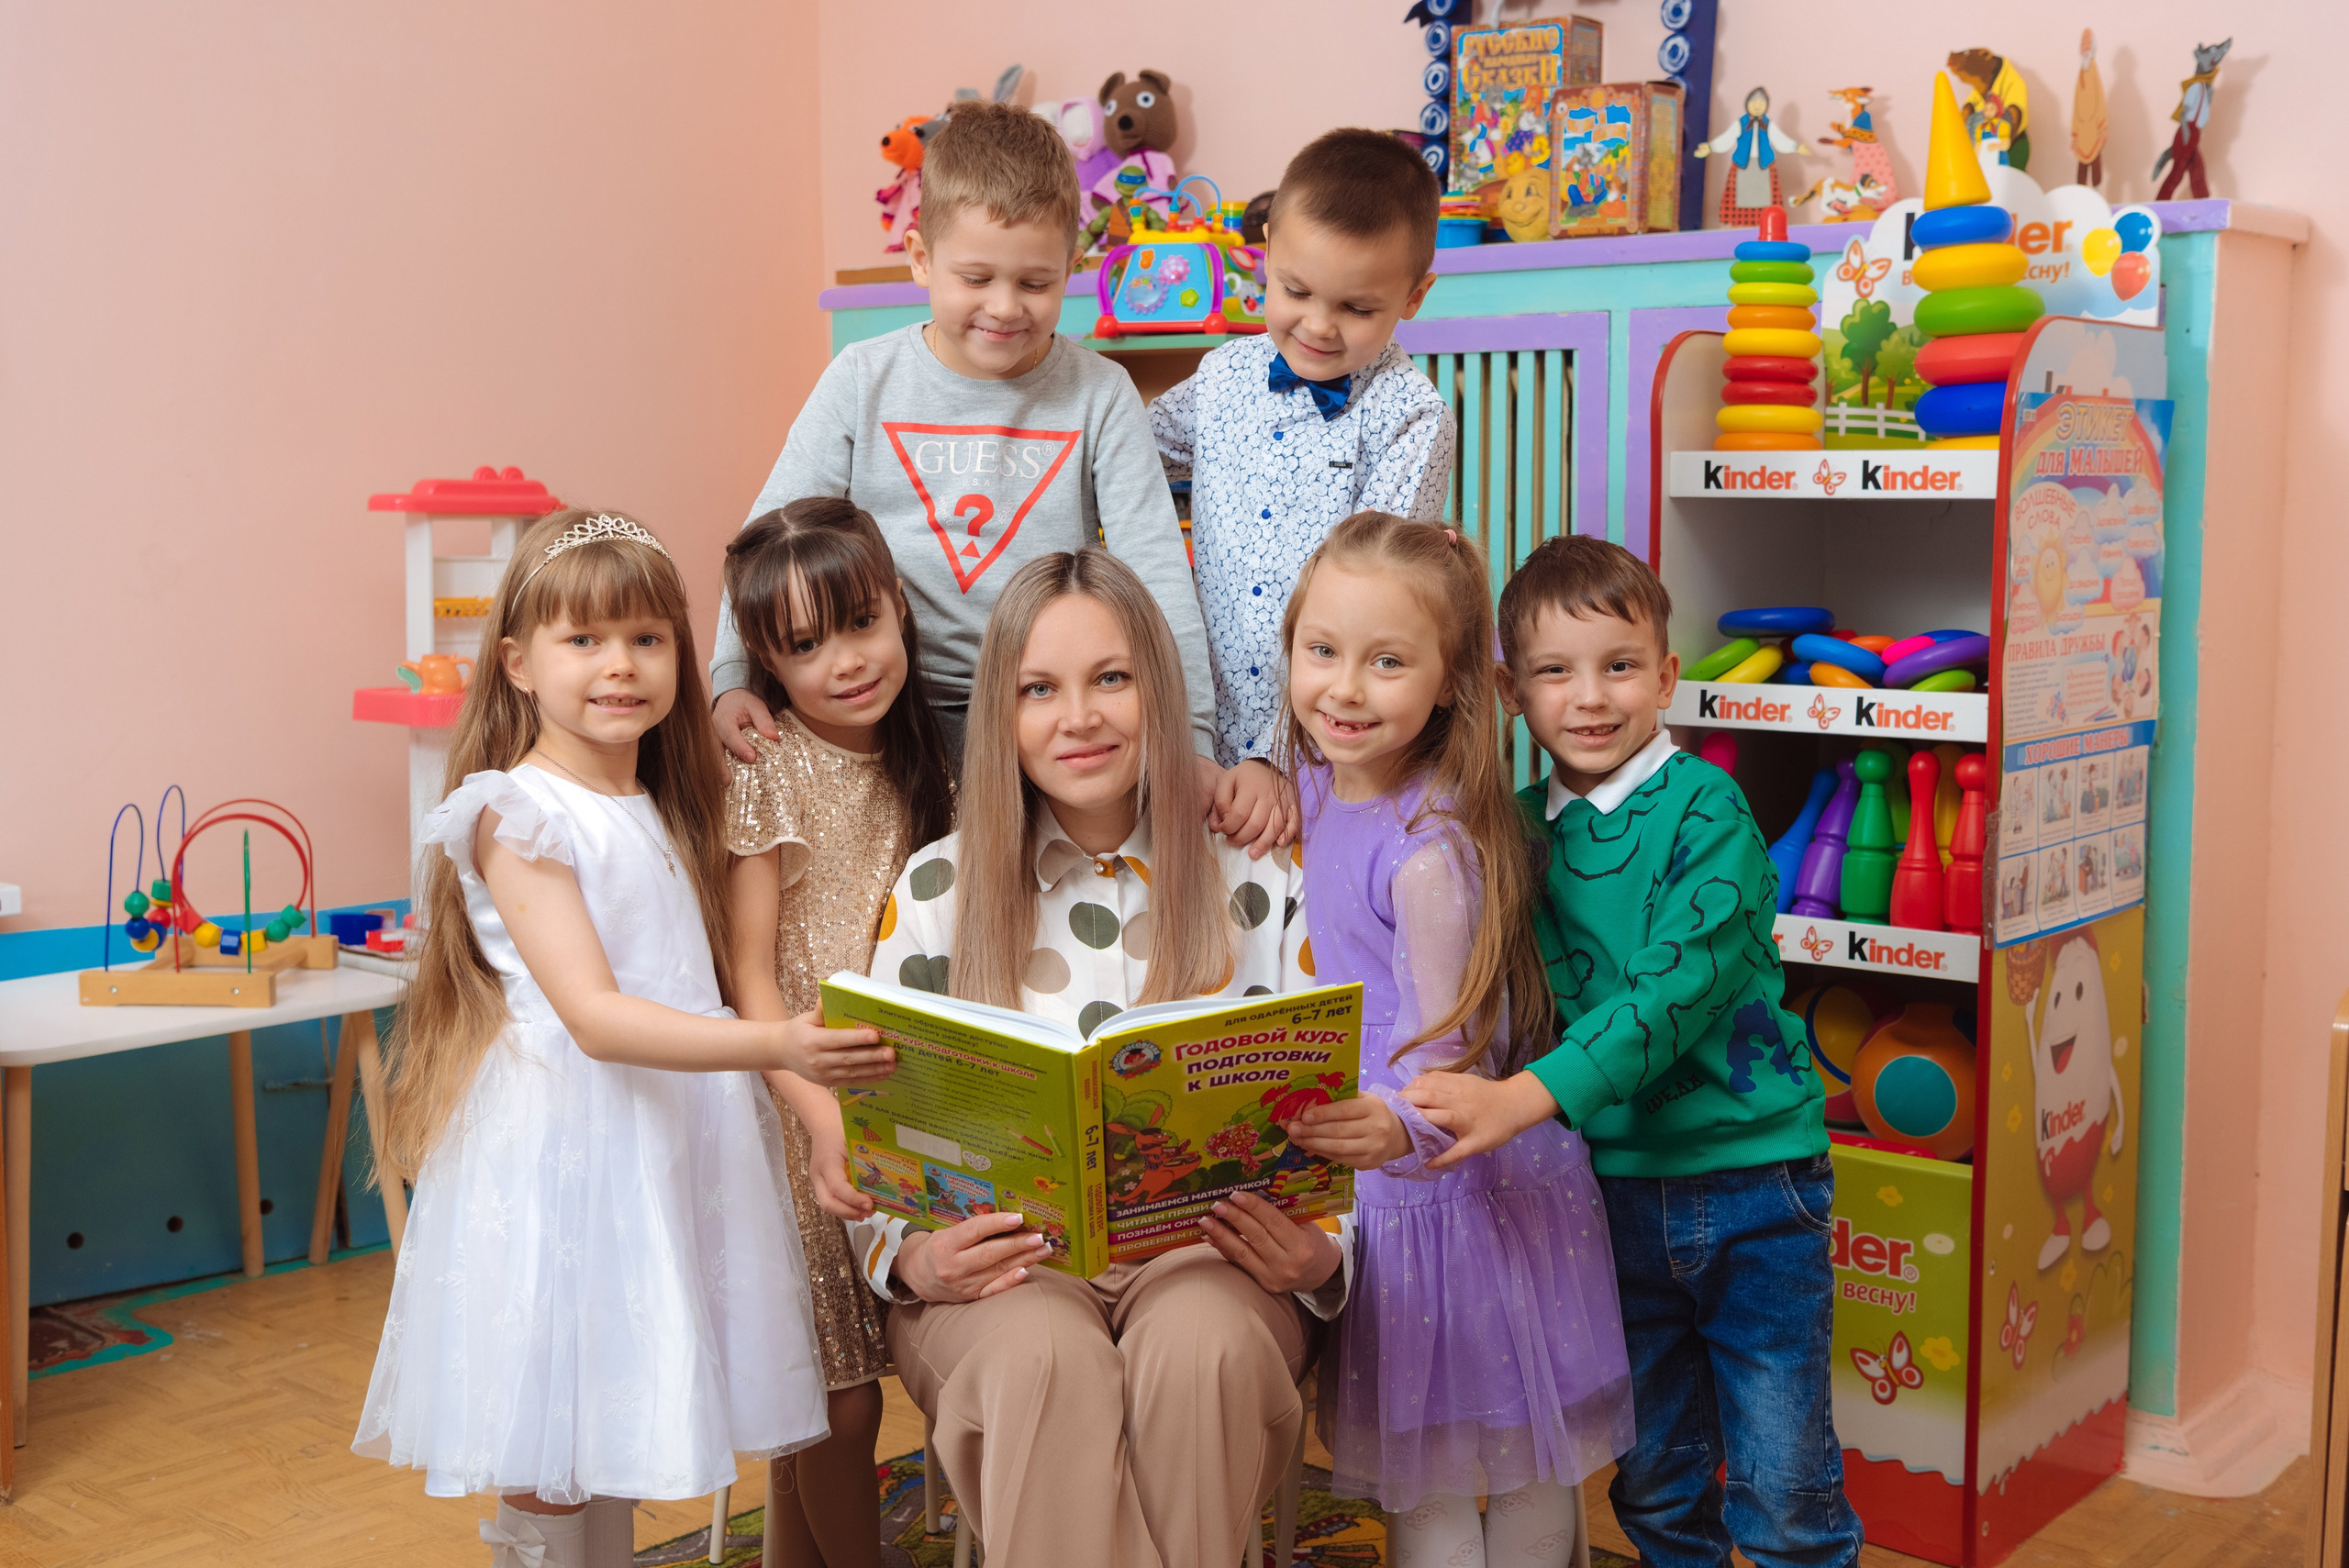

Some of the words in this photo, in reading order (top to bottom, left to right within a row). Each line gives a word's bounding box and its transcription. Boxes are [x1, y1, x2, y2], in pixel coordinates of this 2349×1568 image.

[2055, 403, 2134, 442] ЭТИКЕТ
[915, 440, 1041, 479] GUESS
[2068, 441, 2144, 475] МАЛЫШЕЙ
[996, 499, 1015, 525] JEANS
[2015, 487, 2077, 521] ВОЛШЕБНЫЕ
[2027, 509, 2061, 529] СЛОВА
[2008, 641, 2056, 662] ПРАВИЛА
[2060, 633, 2106, 657] ДРУЖБЫ
[2024, 735, 2080, 764] ХОРОШИЕ
[2083, 727, 2130, 753] МАНЕРЫ
[1224, 1017, 1248, 1028] ДЛЯ
[1250, 1000, 1317, 1022] ОДАРЁННЫХ
[1319, 994, 1353, 1007] ДЕТЕЙ
[1325, 1004, 1353, 1018] лет
[878, 1007, 912, 1021] Элитное
[914, 1018, 968, 1038] образование
[969, 1033, 1008, 1051] доступно
[907, 1024, 940, 1038] вашему
[893, 1041, 915, 1053] для
[918, 1047, 952, 1064] детей
[980, 1066, 1000, 1077] лет
[889, 1118, 927, 1133] Откройте
[928, 1129, 954, 1141] талант
[891, 1111, 927, 1126] развития
[929, 1122, 957, 1135] вашего
[1002, 1143, 1026, 1155] одной
[1086, 1150, 1097, 1171] лет
[1116, 1195, 1189, 1218] ЗАНИМАЕМСЯ
[1191, 1177, 1271, 1202] МАТЕМАТИКОЙ
[1117, 1211, 1165, 1229] ЧИТАЕМ
[1117, 1222, 1172, 1240] ПОЗНАЁМ
[1118, 1231, 1186, 1253] ПРОВЕРЯЕМ
[1830, 1219, 1912, 1279] der
[1842, 1281, 1917, 1315] весну!
